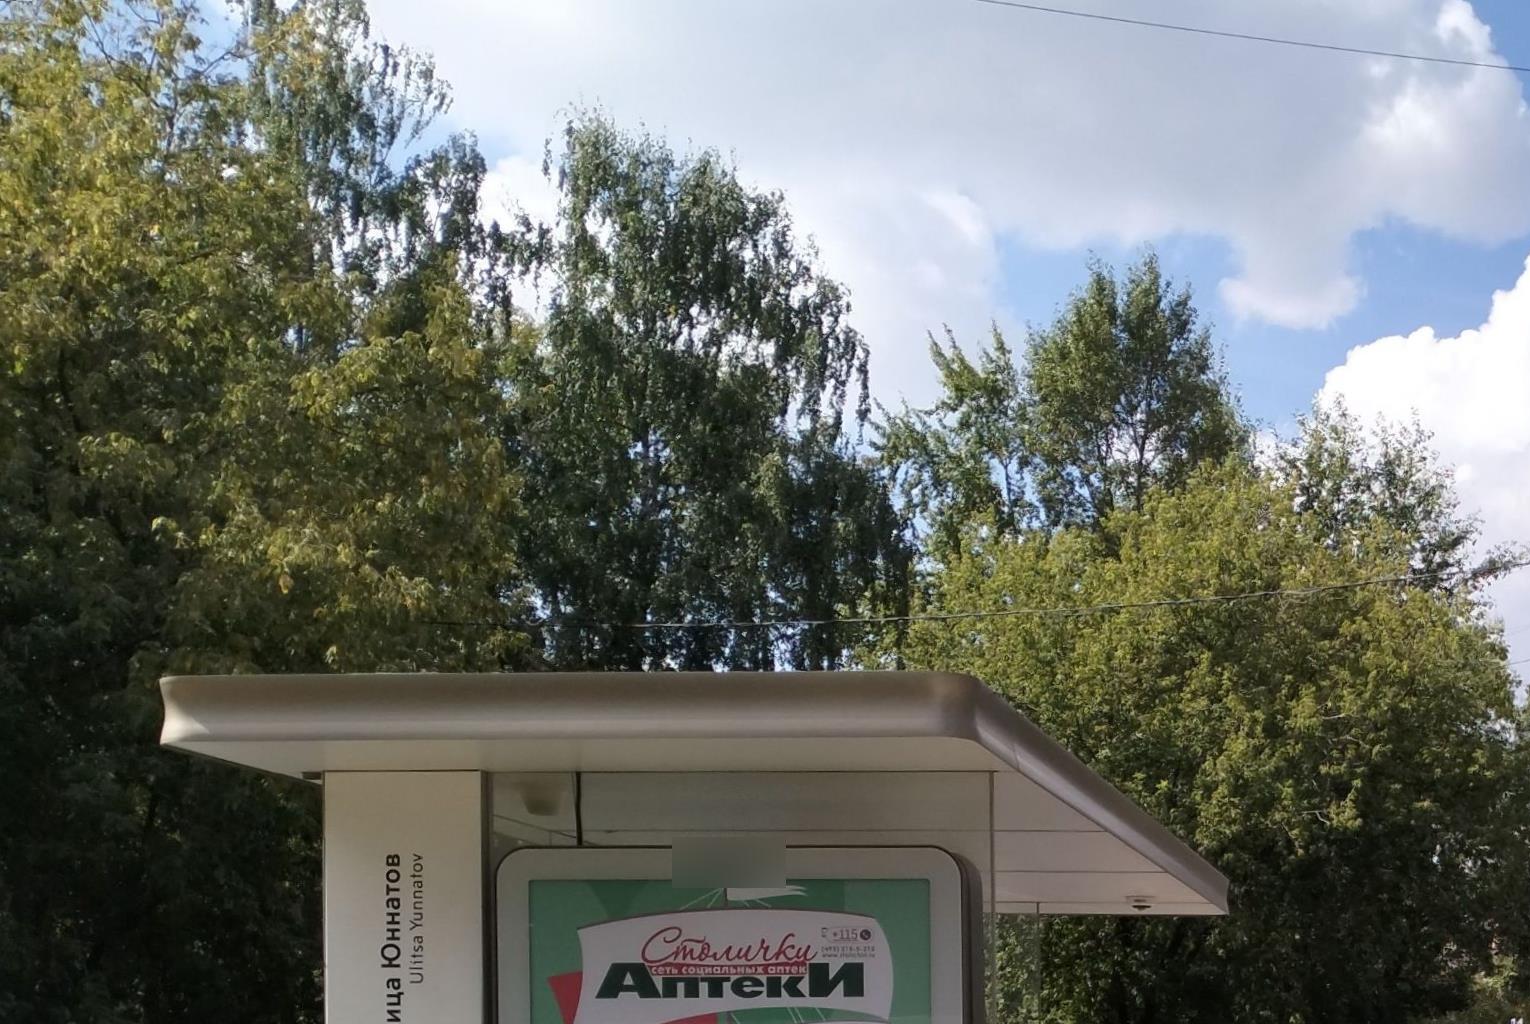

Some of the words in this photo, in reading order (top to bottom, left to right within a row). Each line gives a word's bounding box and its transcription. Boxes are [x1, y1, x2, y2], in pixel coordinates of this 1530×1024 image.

[381, 854, 401, 968] Юннатов
[409, 853, 424, 931] Yunnatov
[409, 935, 424, 984] Ulitsa
[641, 926, 818, 964] Столички
[651, 965, 679, 975] сеть
[681, 965, 764, 976] социальных
[767, 965, 807, 975] аптек
